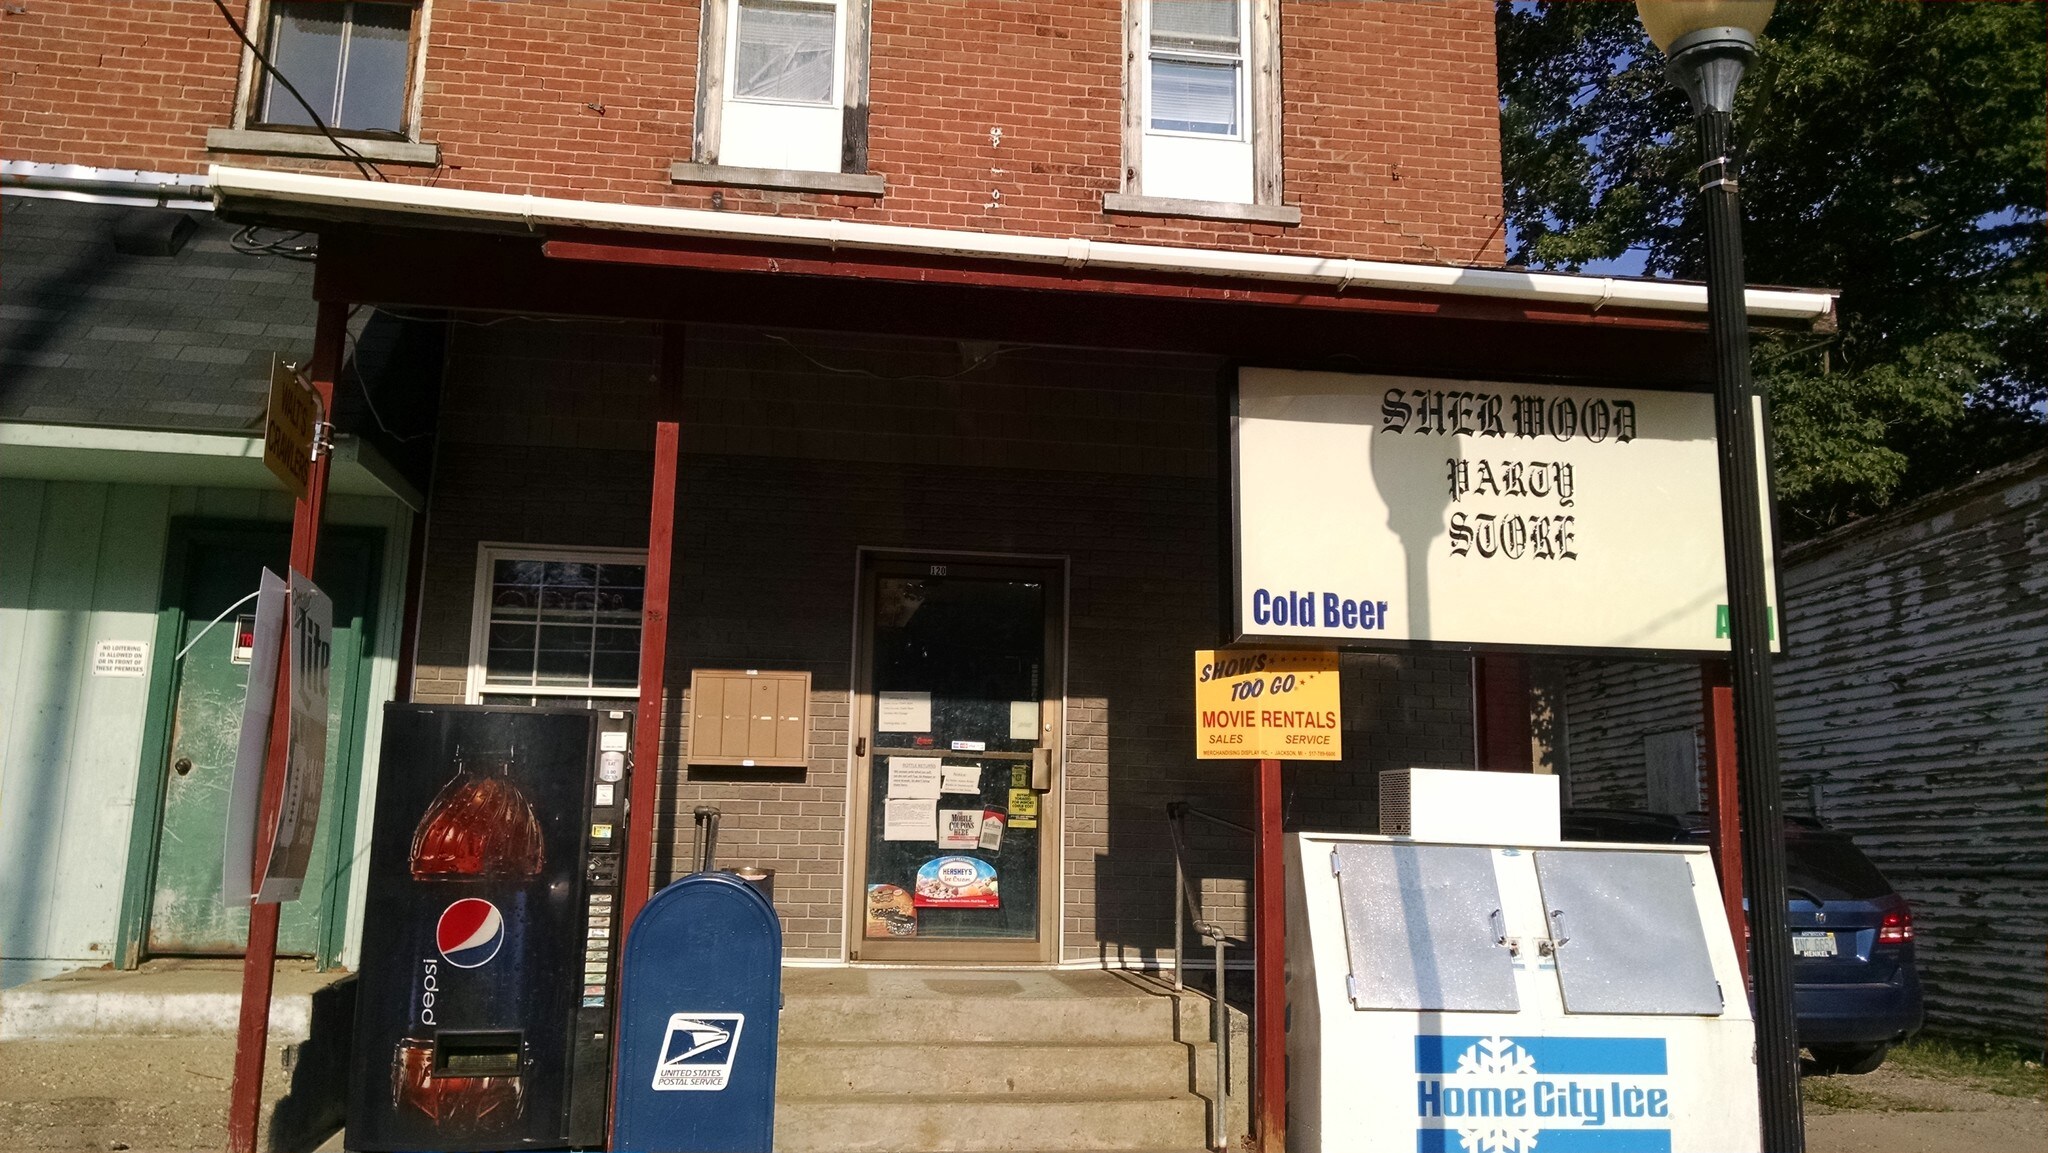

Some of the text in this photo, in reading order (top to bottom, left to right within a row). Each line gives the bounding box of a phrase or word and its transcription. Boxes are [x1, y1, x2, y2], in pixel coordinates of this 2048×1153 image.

[1380, 388, 1638, 444] SHERWOOD
[1446, 457, 1575, 508] PARTY
[1448, 511, 1578, 561] STORE
[931, 565, 946, 576] 120
[1253, 588, 1388, 630] Cold Beer
[1200, 653, 1267, 683] SHOWS
[1231, 674, 1296, 702] TOO GO
[1202, 710, 1337, 729] MOVIE RENTALS
[1208, 734, 1331, 745] SALES SERVICE
[949, 821, 975, 832] COUPONS
[951, 814, 973, 822] MOBILE
[953, 828, 970, 836] HERE
[942, 868, 973, 876] HERSHEY'S
[421, 958, 440, 1026] pepsi
[658, 1078, 723, 1086] POSTAL SERVICE
[660, 1069, 722, 1077] UNITED STATES
[1417, 1080, 1669, 1126] Home City Ice
